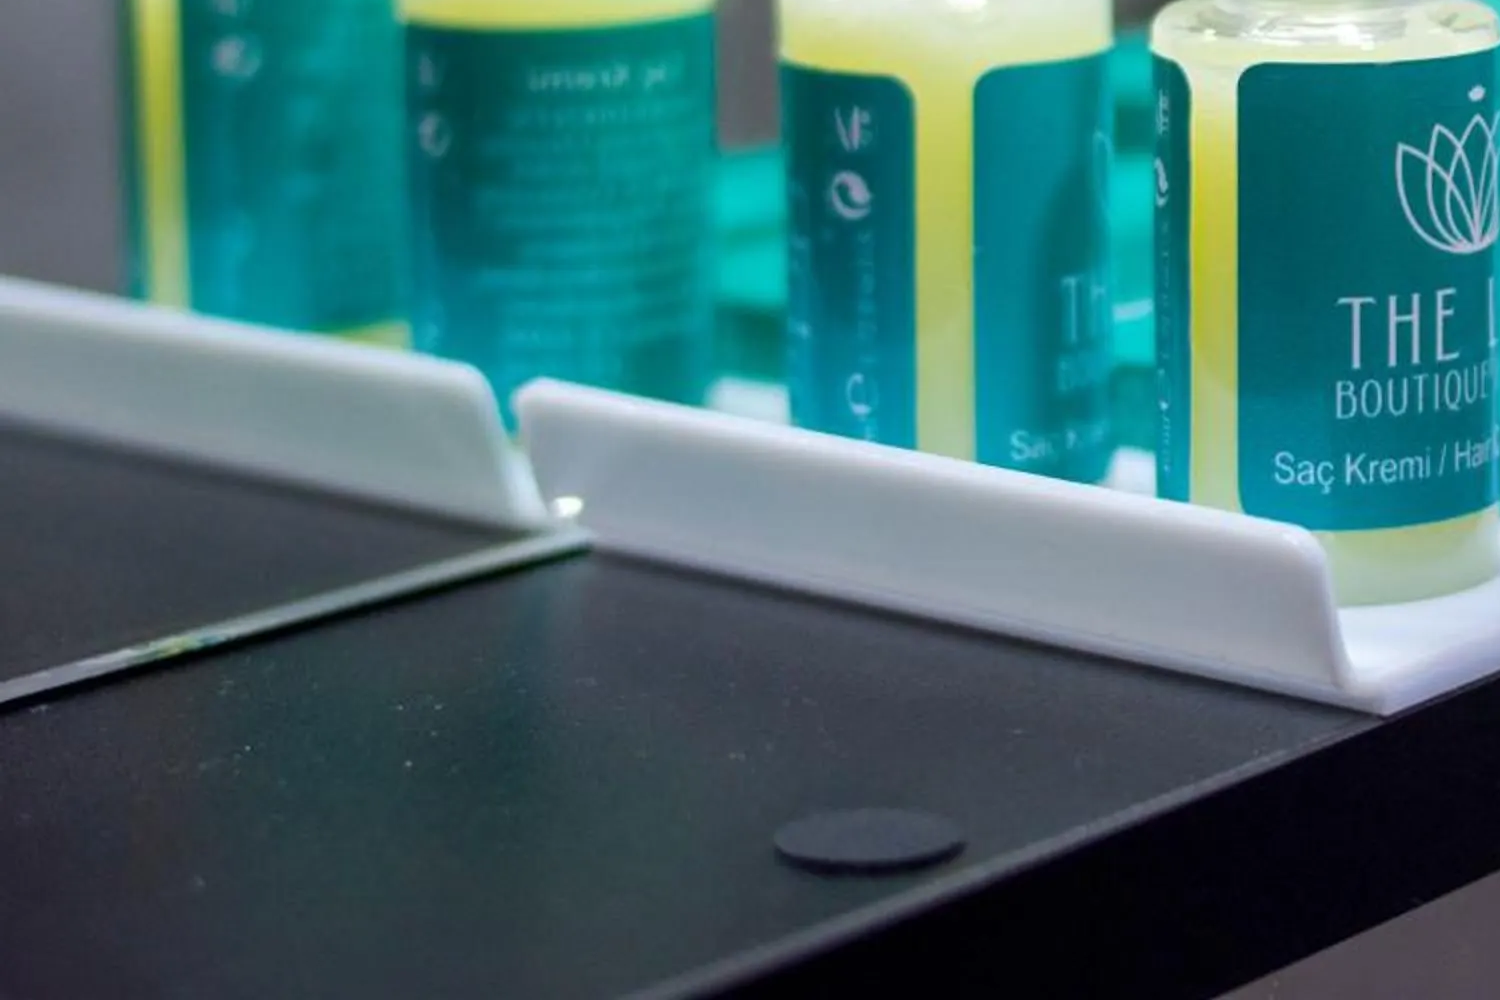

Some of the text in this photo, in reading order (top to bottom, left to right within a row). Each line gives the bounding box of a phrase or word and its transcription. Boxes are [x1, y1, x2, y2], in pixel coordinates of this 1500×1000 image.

[1335, 286, 1460, 370] THE
[1336, 361, 1490, 420] BOUTIQUE
[1274, 450, 1336, 494] Saç
[1345, 447, 1430, 486] Kremi
